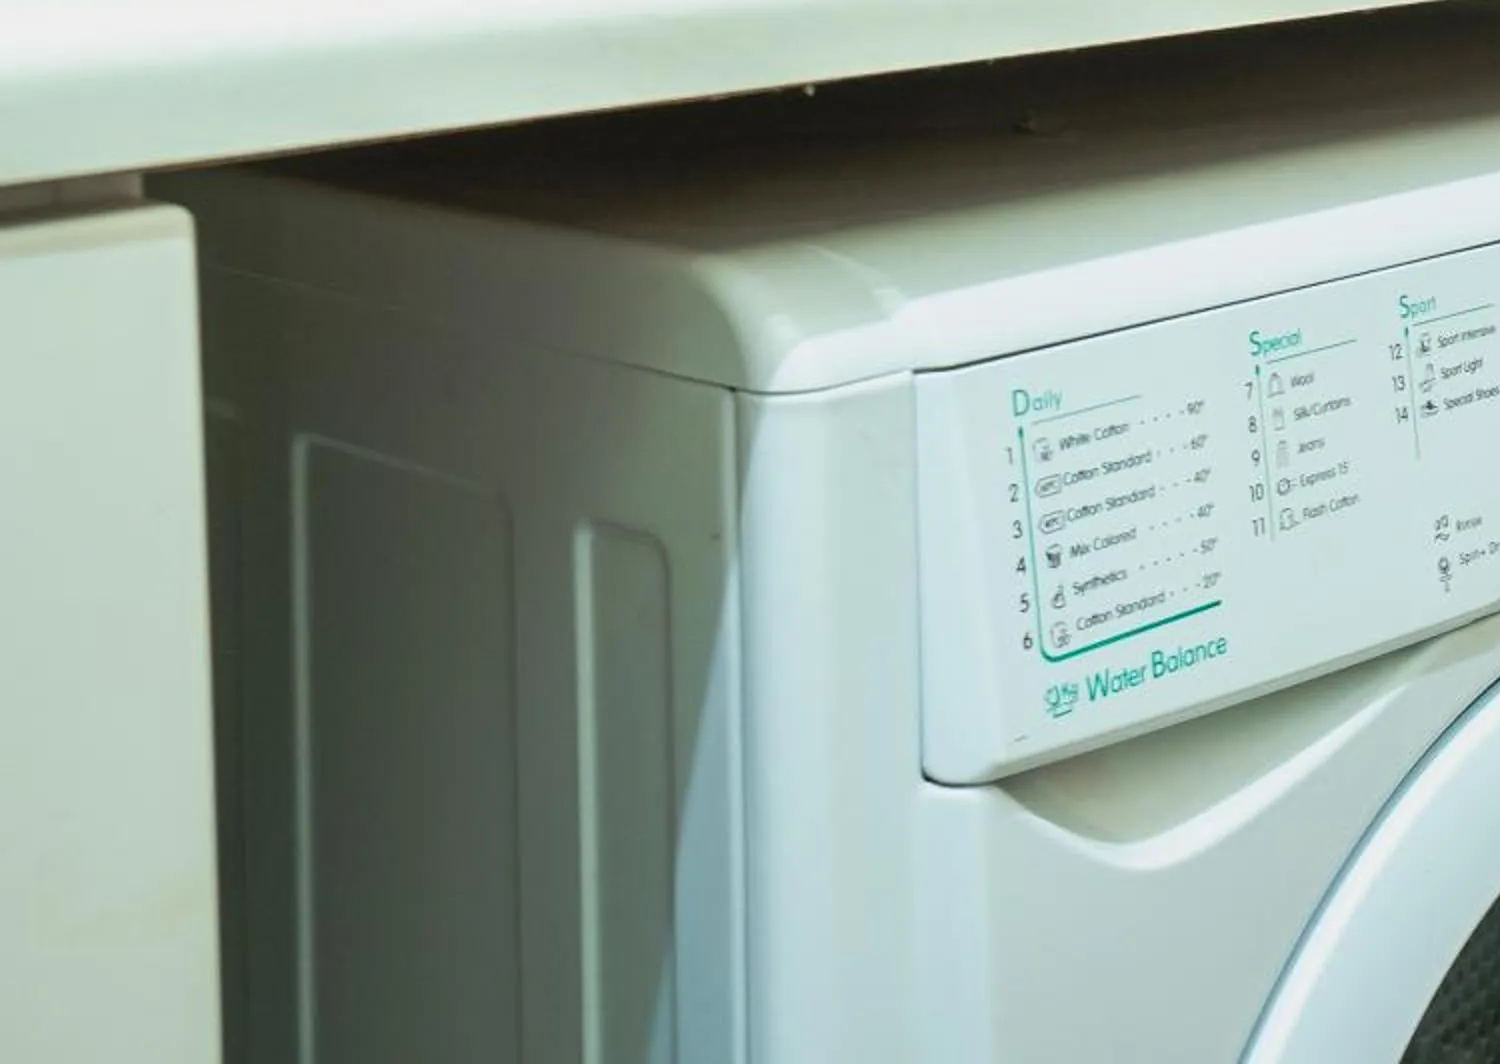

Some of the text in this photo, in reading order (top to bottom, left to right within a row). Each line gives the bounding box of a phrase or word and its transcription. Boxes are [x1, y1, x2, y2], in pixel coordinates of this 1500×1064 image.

[1399, 295, 1437, 318] Sport
[1249, 328, 1303, 357] Special
[1388, 343, 1404, 361] 12
[1391, 375, 1406, 393] 13
[1011, 388, 1063, 417] Daily
[1394, 407, 1409, 424] 14
[1248, 415, 1258, 434] 8
[1005, 447, 1014, 465] 1
[1093, 422, 1130, 442] Cotton
[1251, 449, 1261, 467] 9
[1008, 483, 1019, 503] 2
[1063, 466, 1100, 486] Cotton
[1101, 451, 1153, 475] Standard
[1249, 483, 1265, 503] 10
[1300, 467, 1337, 488] Express
[1012, 520, 1023, 539] 3
[1067, 502, 1102, 523] Cotton
[1106, 485, 1157, 511] Standard
[1252, 517, 1266, 537] 11
[1328, 493, 1360, 512] Cotton
[1016, 556, 1027, 574] 4
[1019, 592, 1030, 613] 5
[1023, 632, 1034, 650] 6
[1076, 609, 1113, 631] Cotton
[1115, 591, 1167, 618] Standard
[1085, 636, 1228, 702] Water Balance
